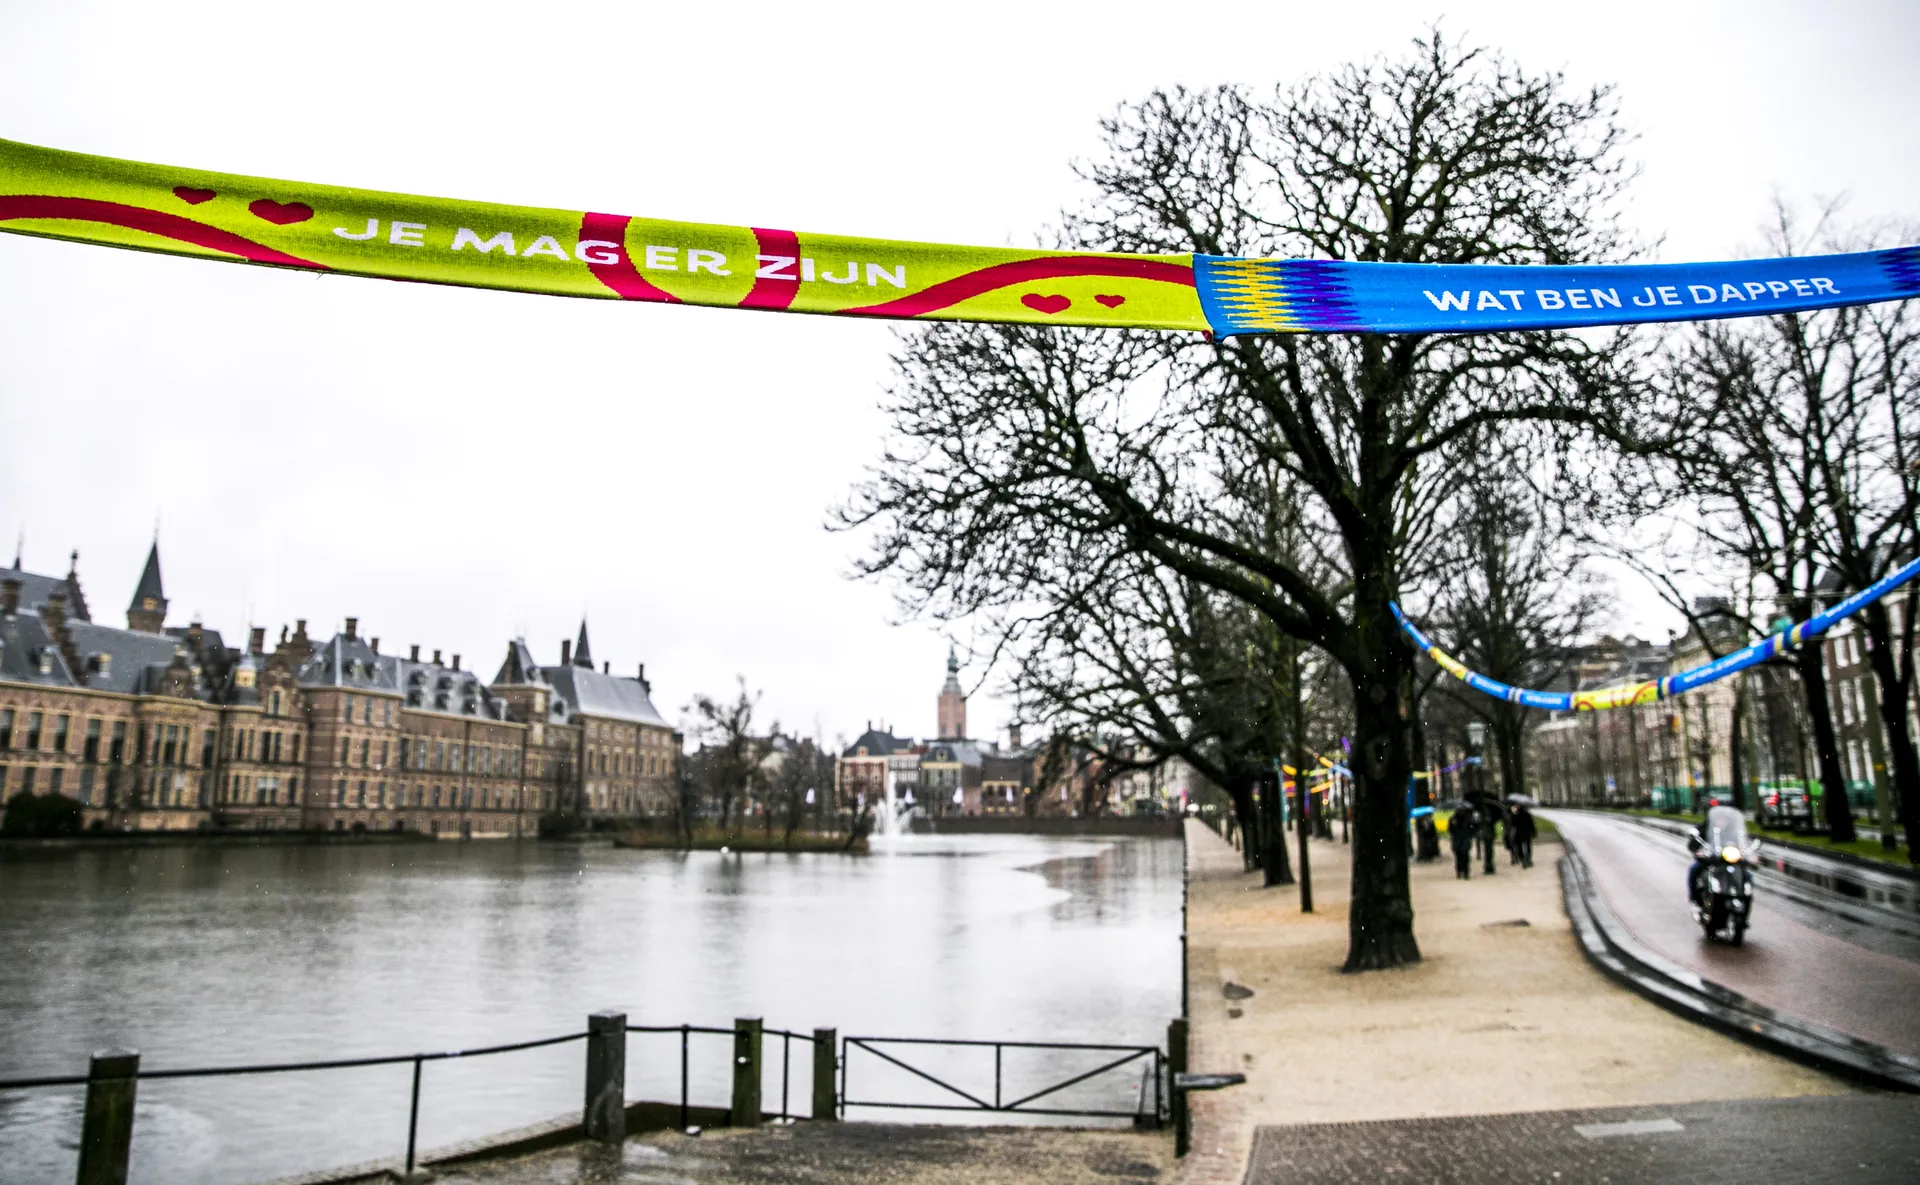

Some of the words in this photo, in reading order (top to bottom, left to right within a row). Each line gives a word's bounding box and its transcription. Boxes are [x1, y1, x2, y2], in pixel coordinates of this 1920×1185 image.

[333, 218, 426, 246] JE
[451, 228, 620, 265] MAG
[645, 244, 732, 281] ER
[754, 254, 907, 289] ZIJN
[1422, 289, 1525, 311] WAT
[1535, 287, 1623, 310] BEN
[1632, 286, 1682, 307] JE
[1687, 277, 1841, 304] DAPPER
